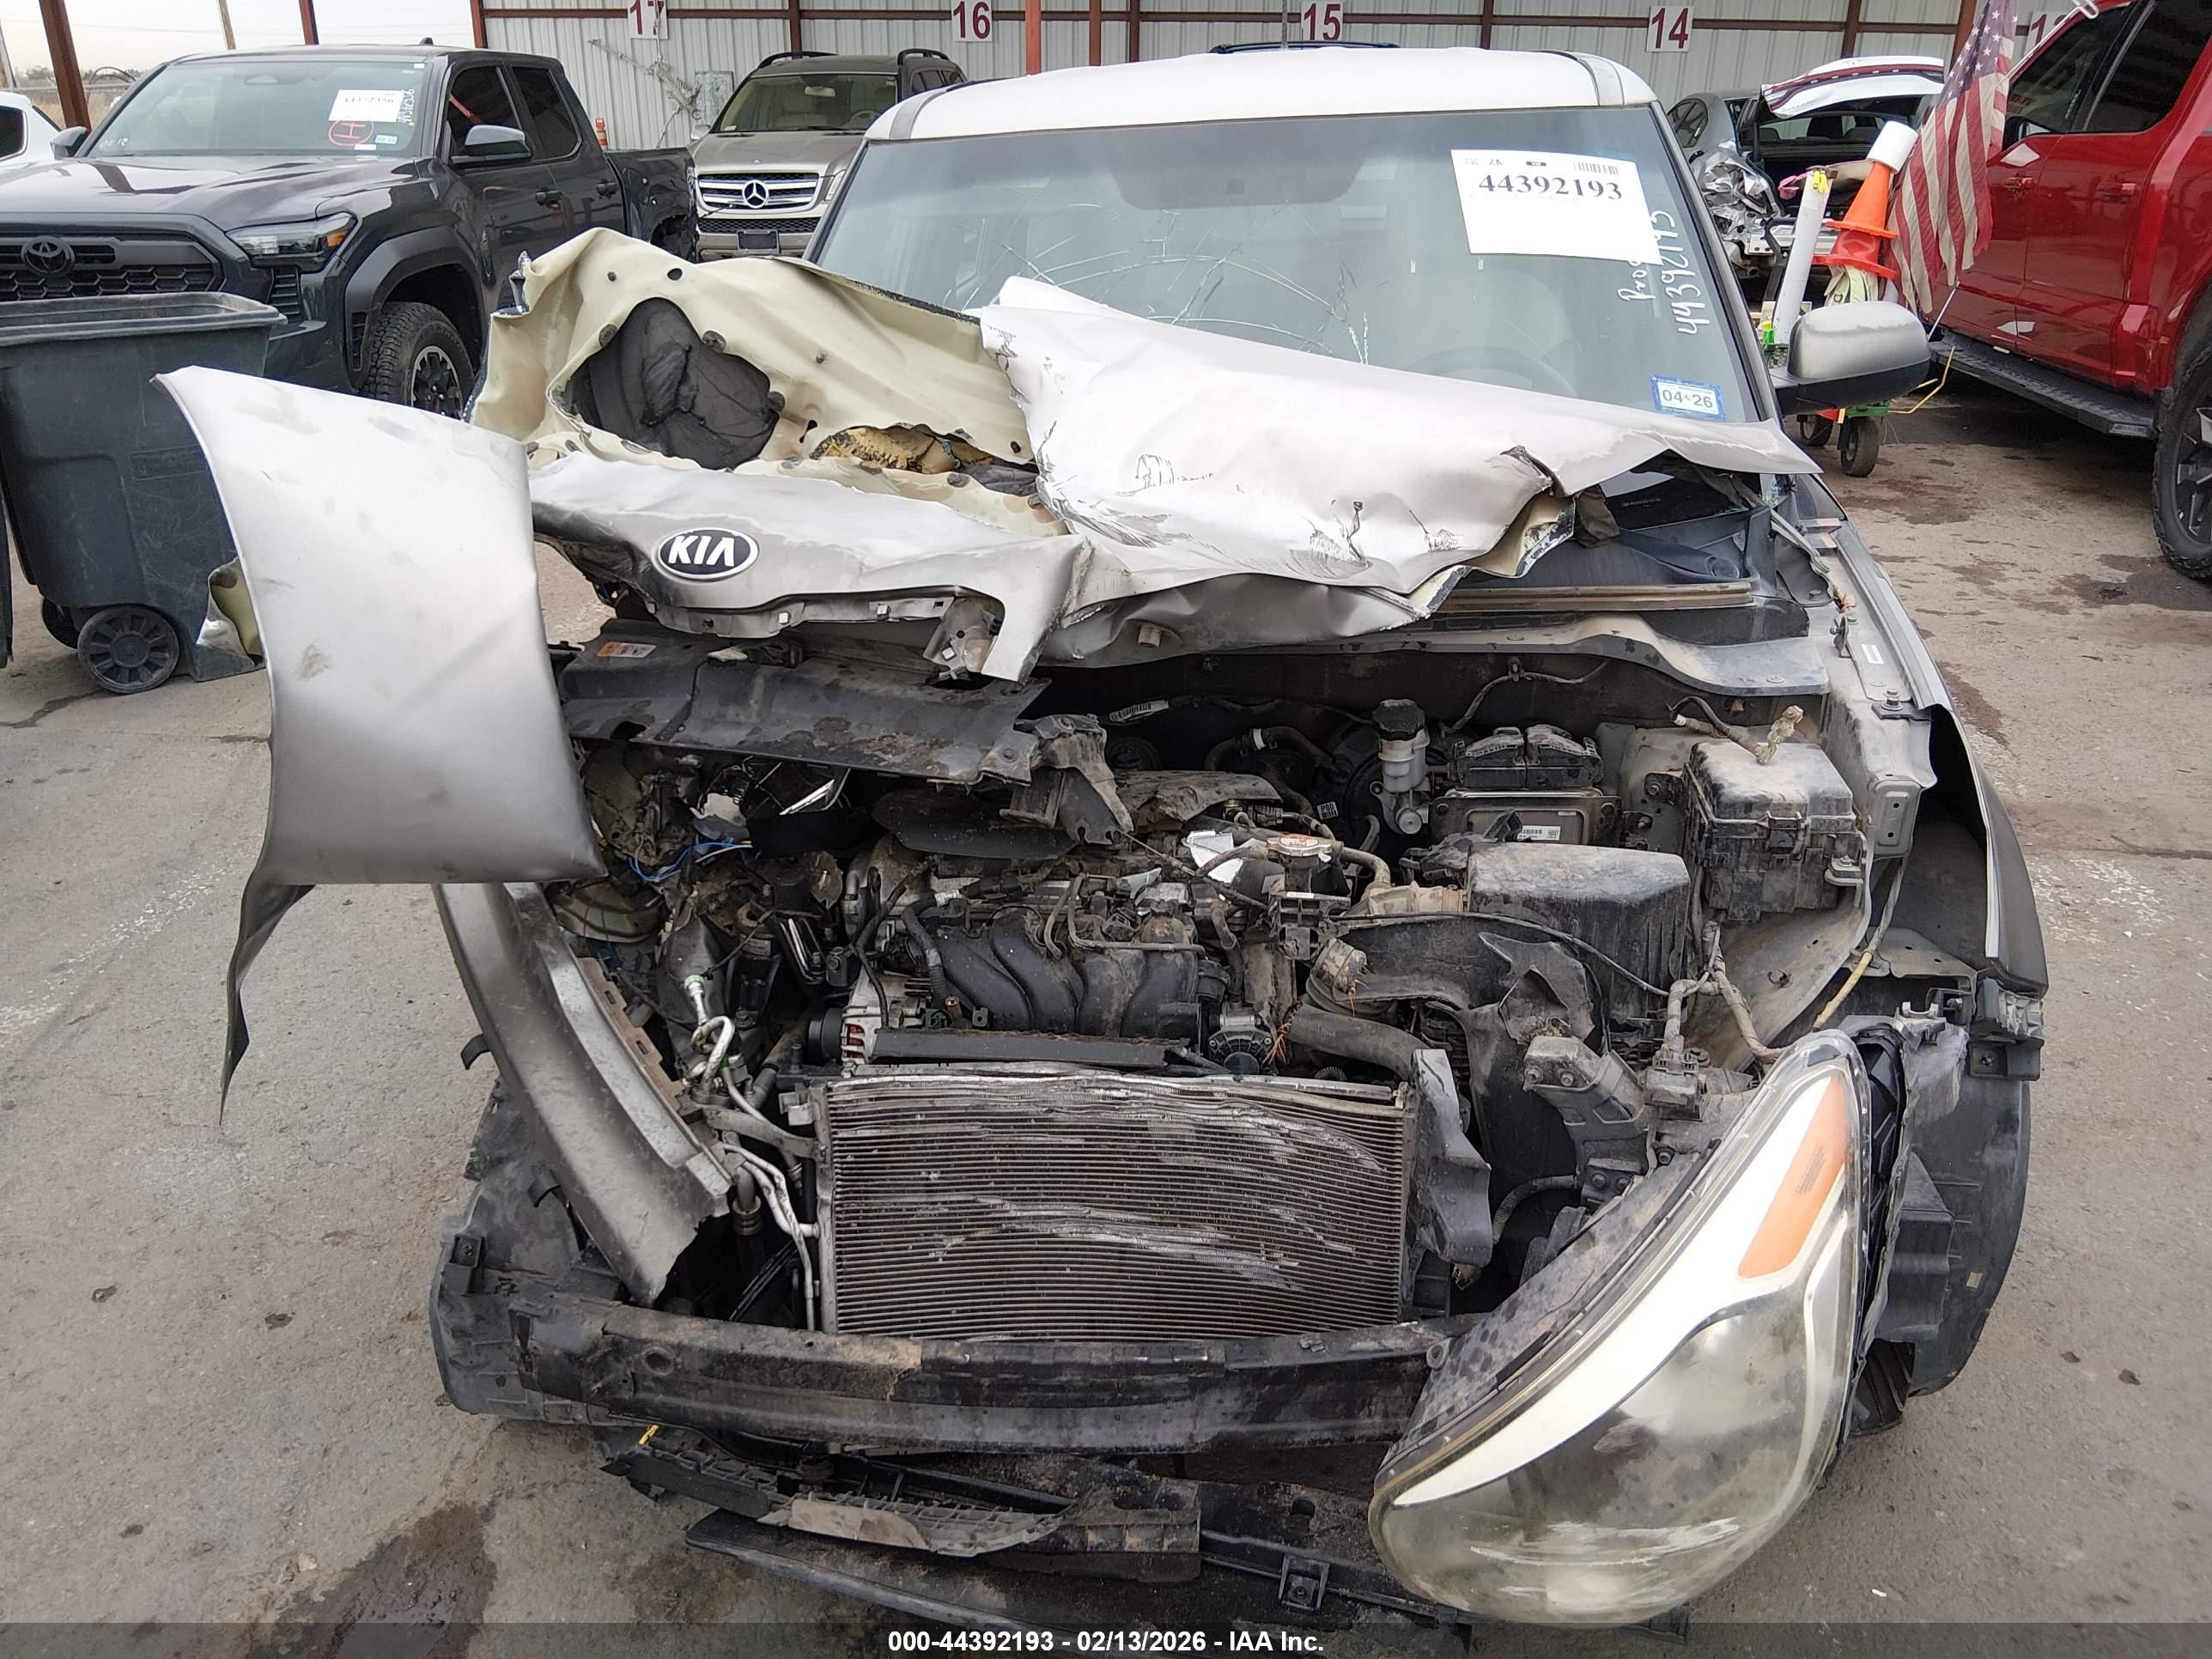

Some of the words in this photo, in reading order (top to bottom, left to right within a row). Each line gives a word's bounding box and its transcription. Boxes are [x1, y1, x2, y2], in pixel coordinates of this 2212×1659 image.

[953, 1, 991, 39] 16
[1304, 3, 1341, 41] 15
[1651, 8, 1689, 49] 14
[1479, 174, 1622, 200] 44392193
[1662, 389, 1683, 404] 04
[1692, 393, 1713, 409] 26
[668, 535, 735, 567] KIA
